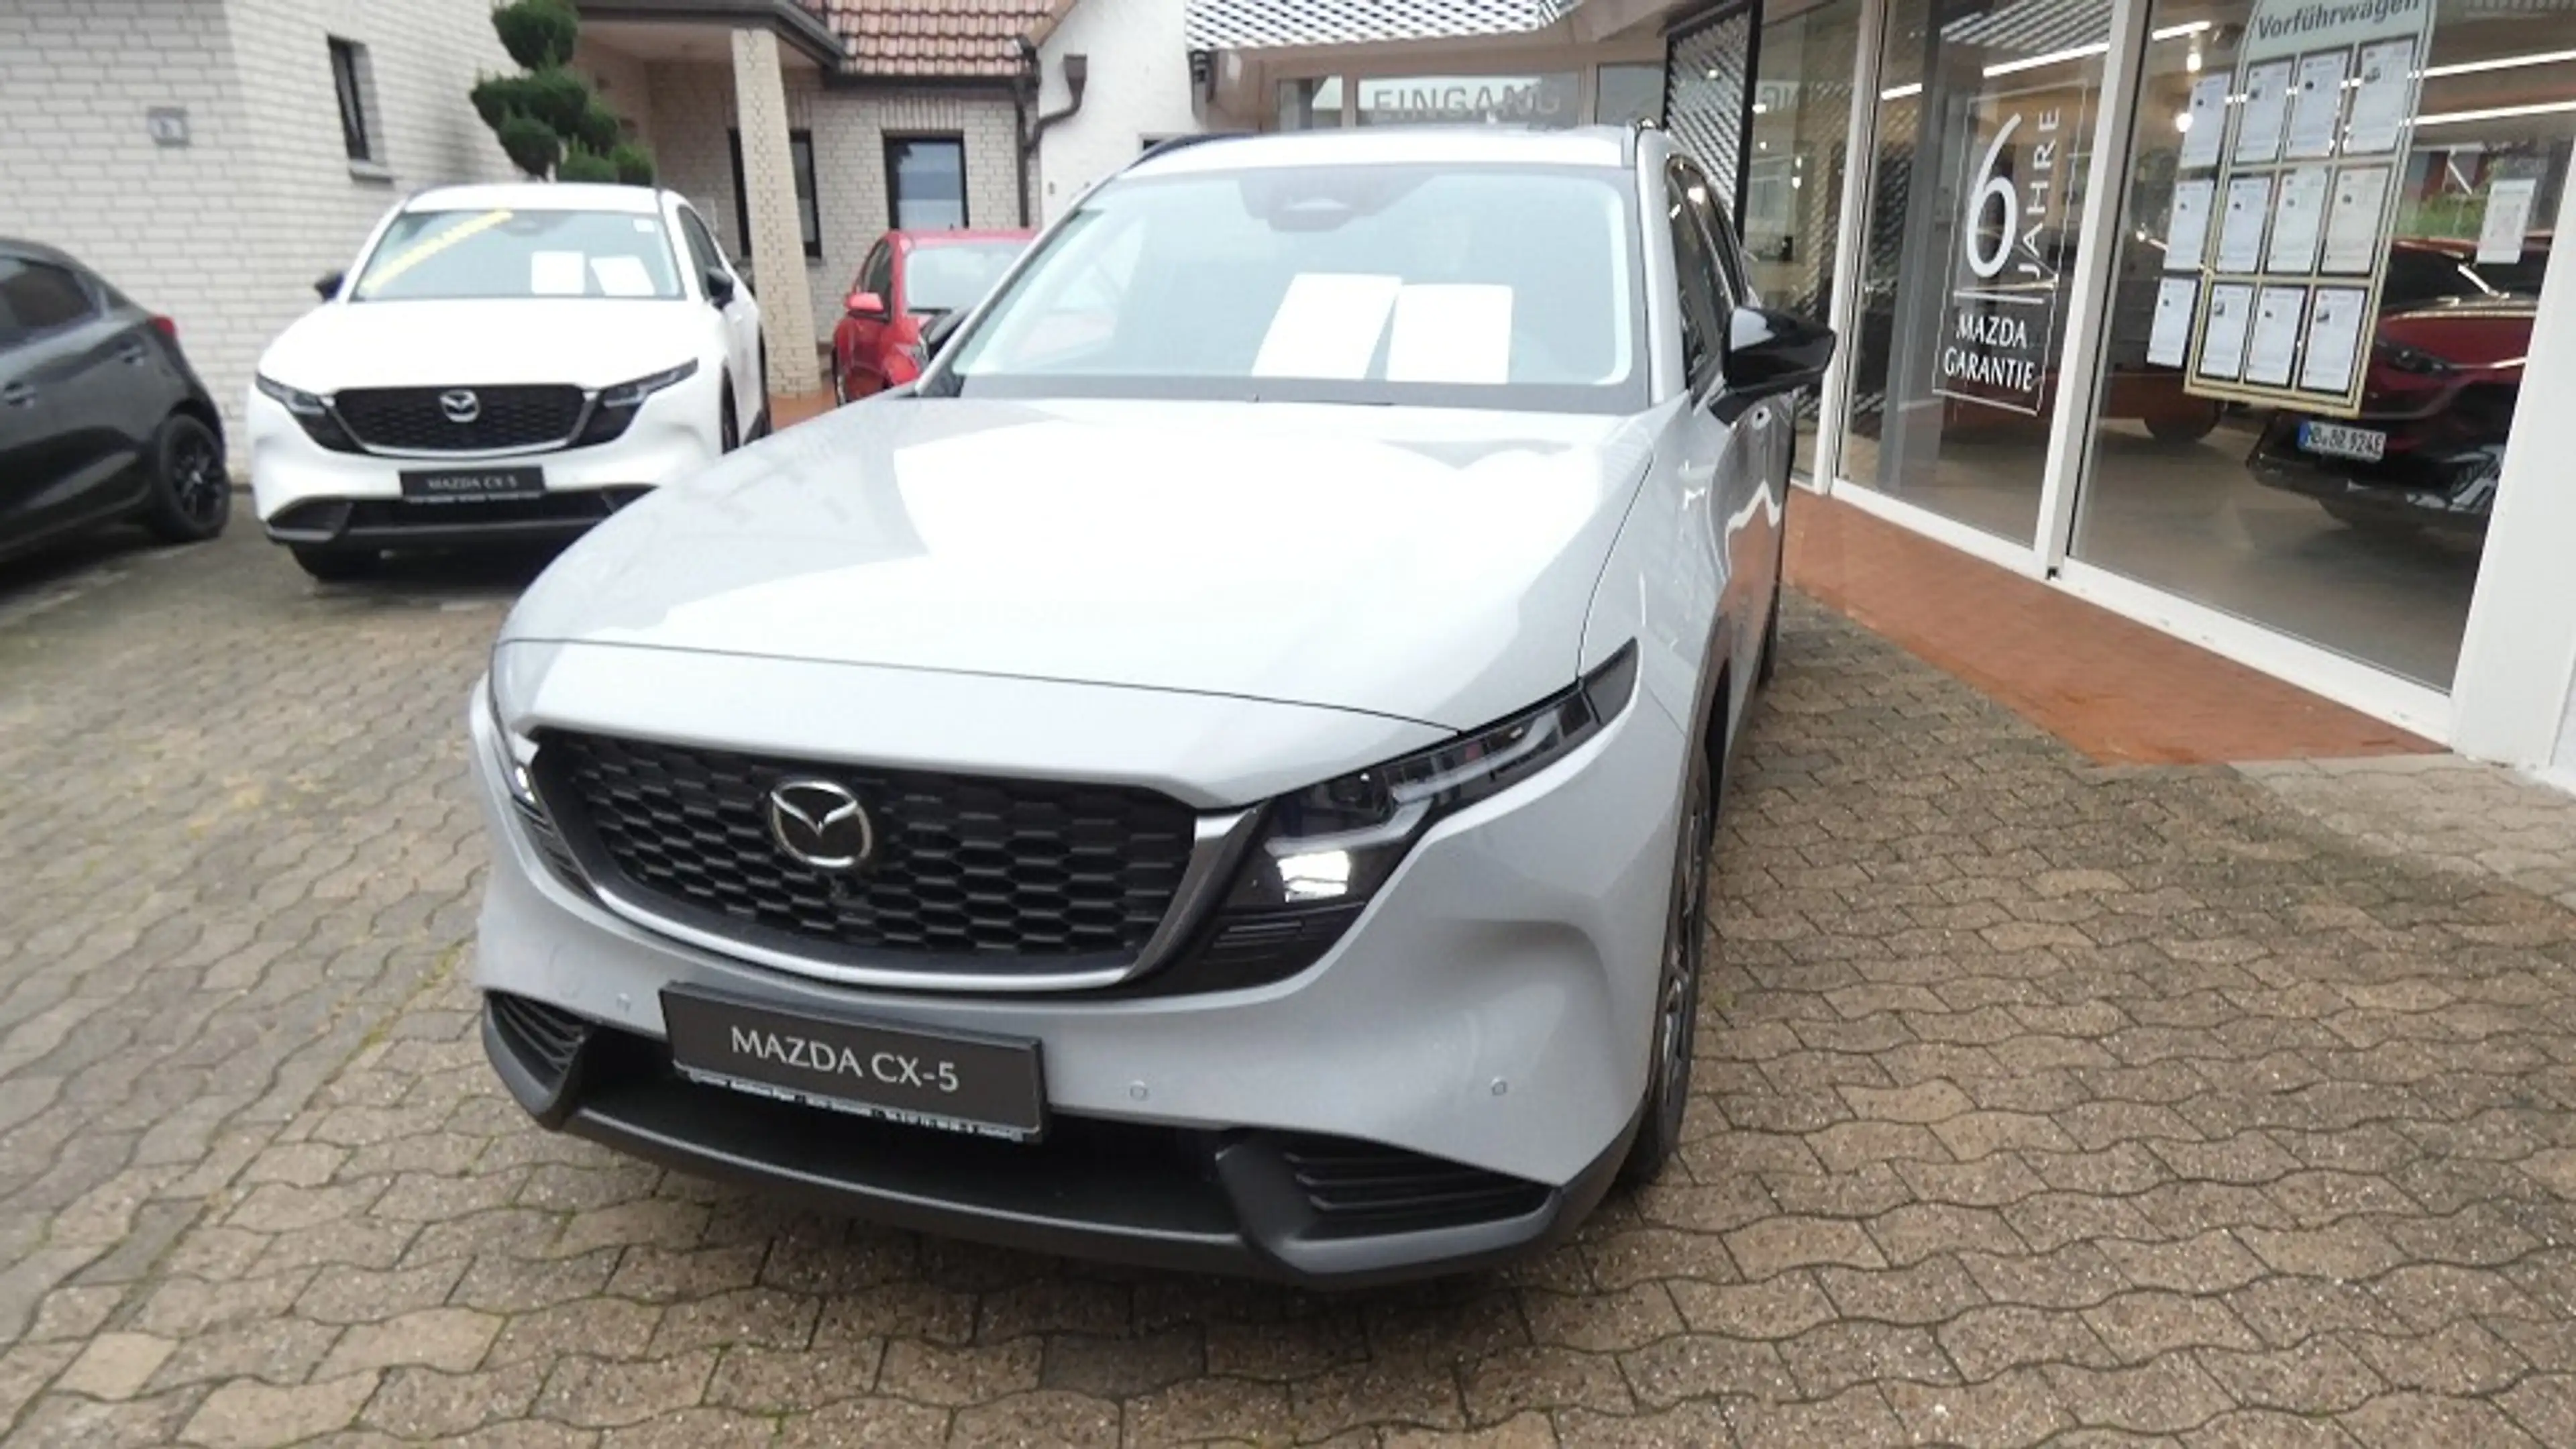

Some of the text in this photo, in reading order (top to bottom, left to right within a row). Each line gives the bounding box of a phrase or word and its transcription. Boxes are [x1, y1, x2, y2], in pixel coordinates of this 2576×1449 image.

[2258, 0, 2420, 40] Vorführwagen
[1967, 112, 2022, 278] 6
[2017, 107, 2059, 280] JAHRE
[1955, 313, 2027, 350] MAZDA
[1945, 346, 2035, 392] GARANTIE
[731, 1025, 959, 1099] MAZDA CX-5
